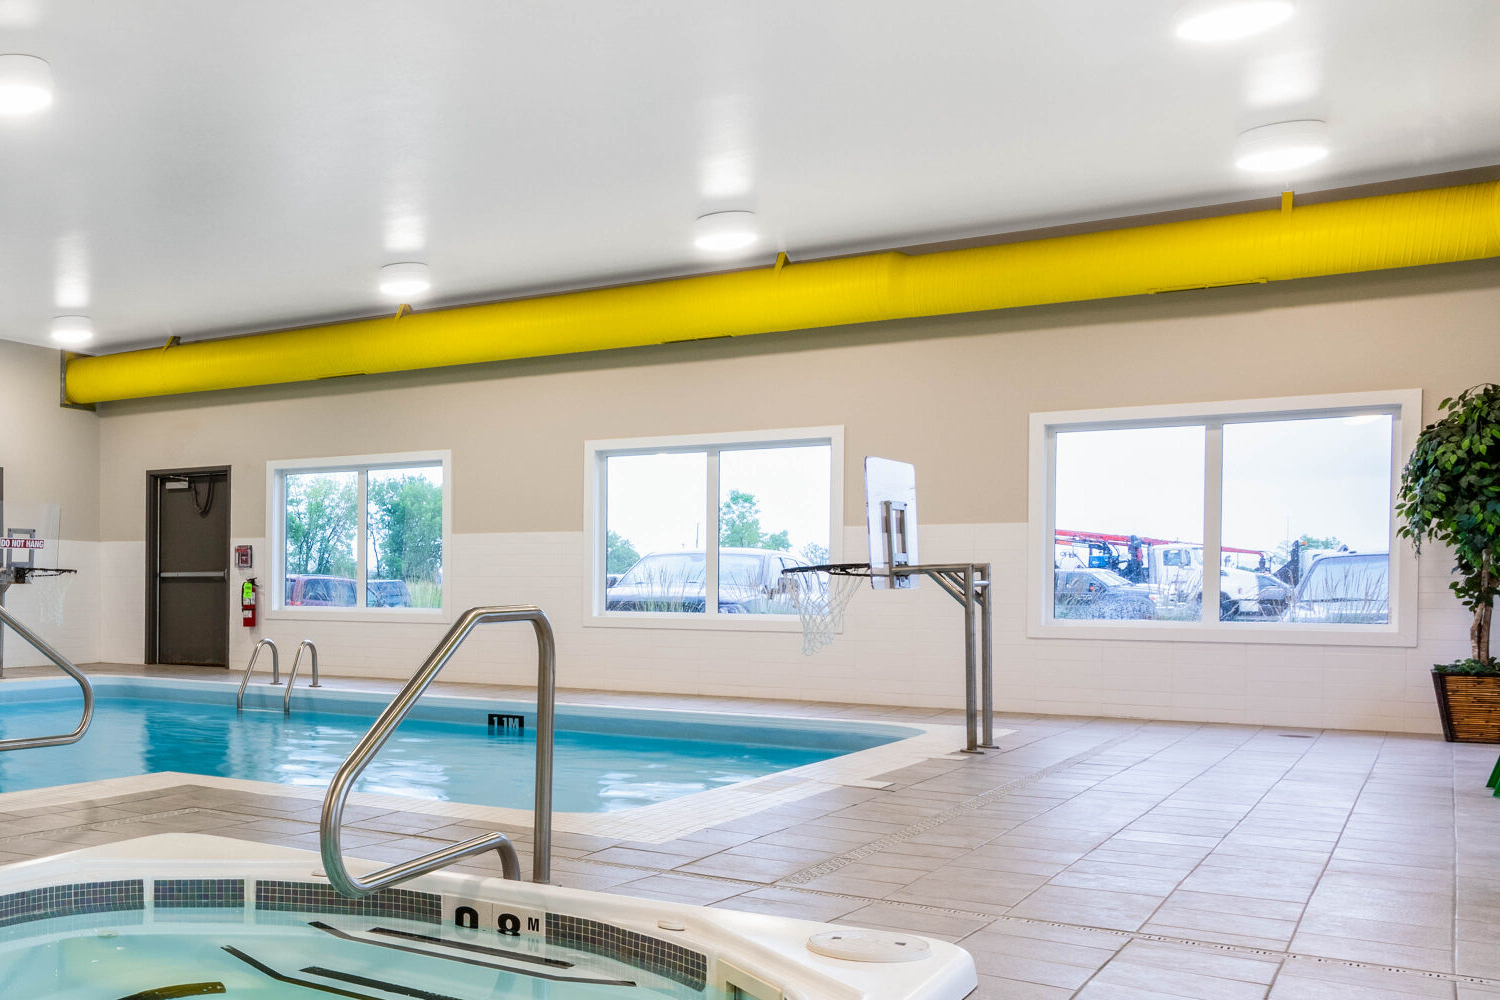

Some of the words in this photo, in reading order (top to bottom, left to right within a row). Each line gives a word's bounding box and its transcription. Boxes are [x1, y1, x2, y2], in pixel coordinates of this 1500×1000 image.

[1, 539, 10, 547] DO
[11, 540, 25, 548] NOT
[26, 540, 44, 548] HANG
[527, 917, 540, 932] M
